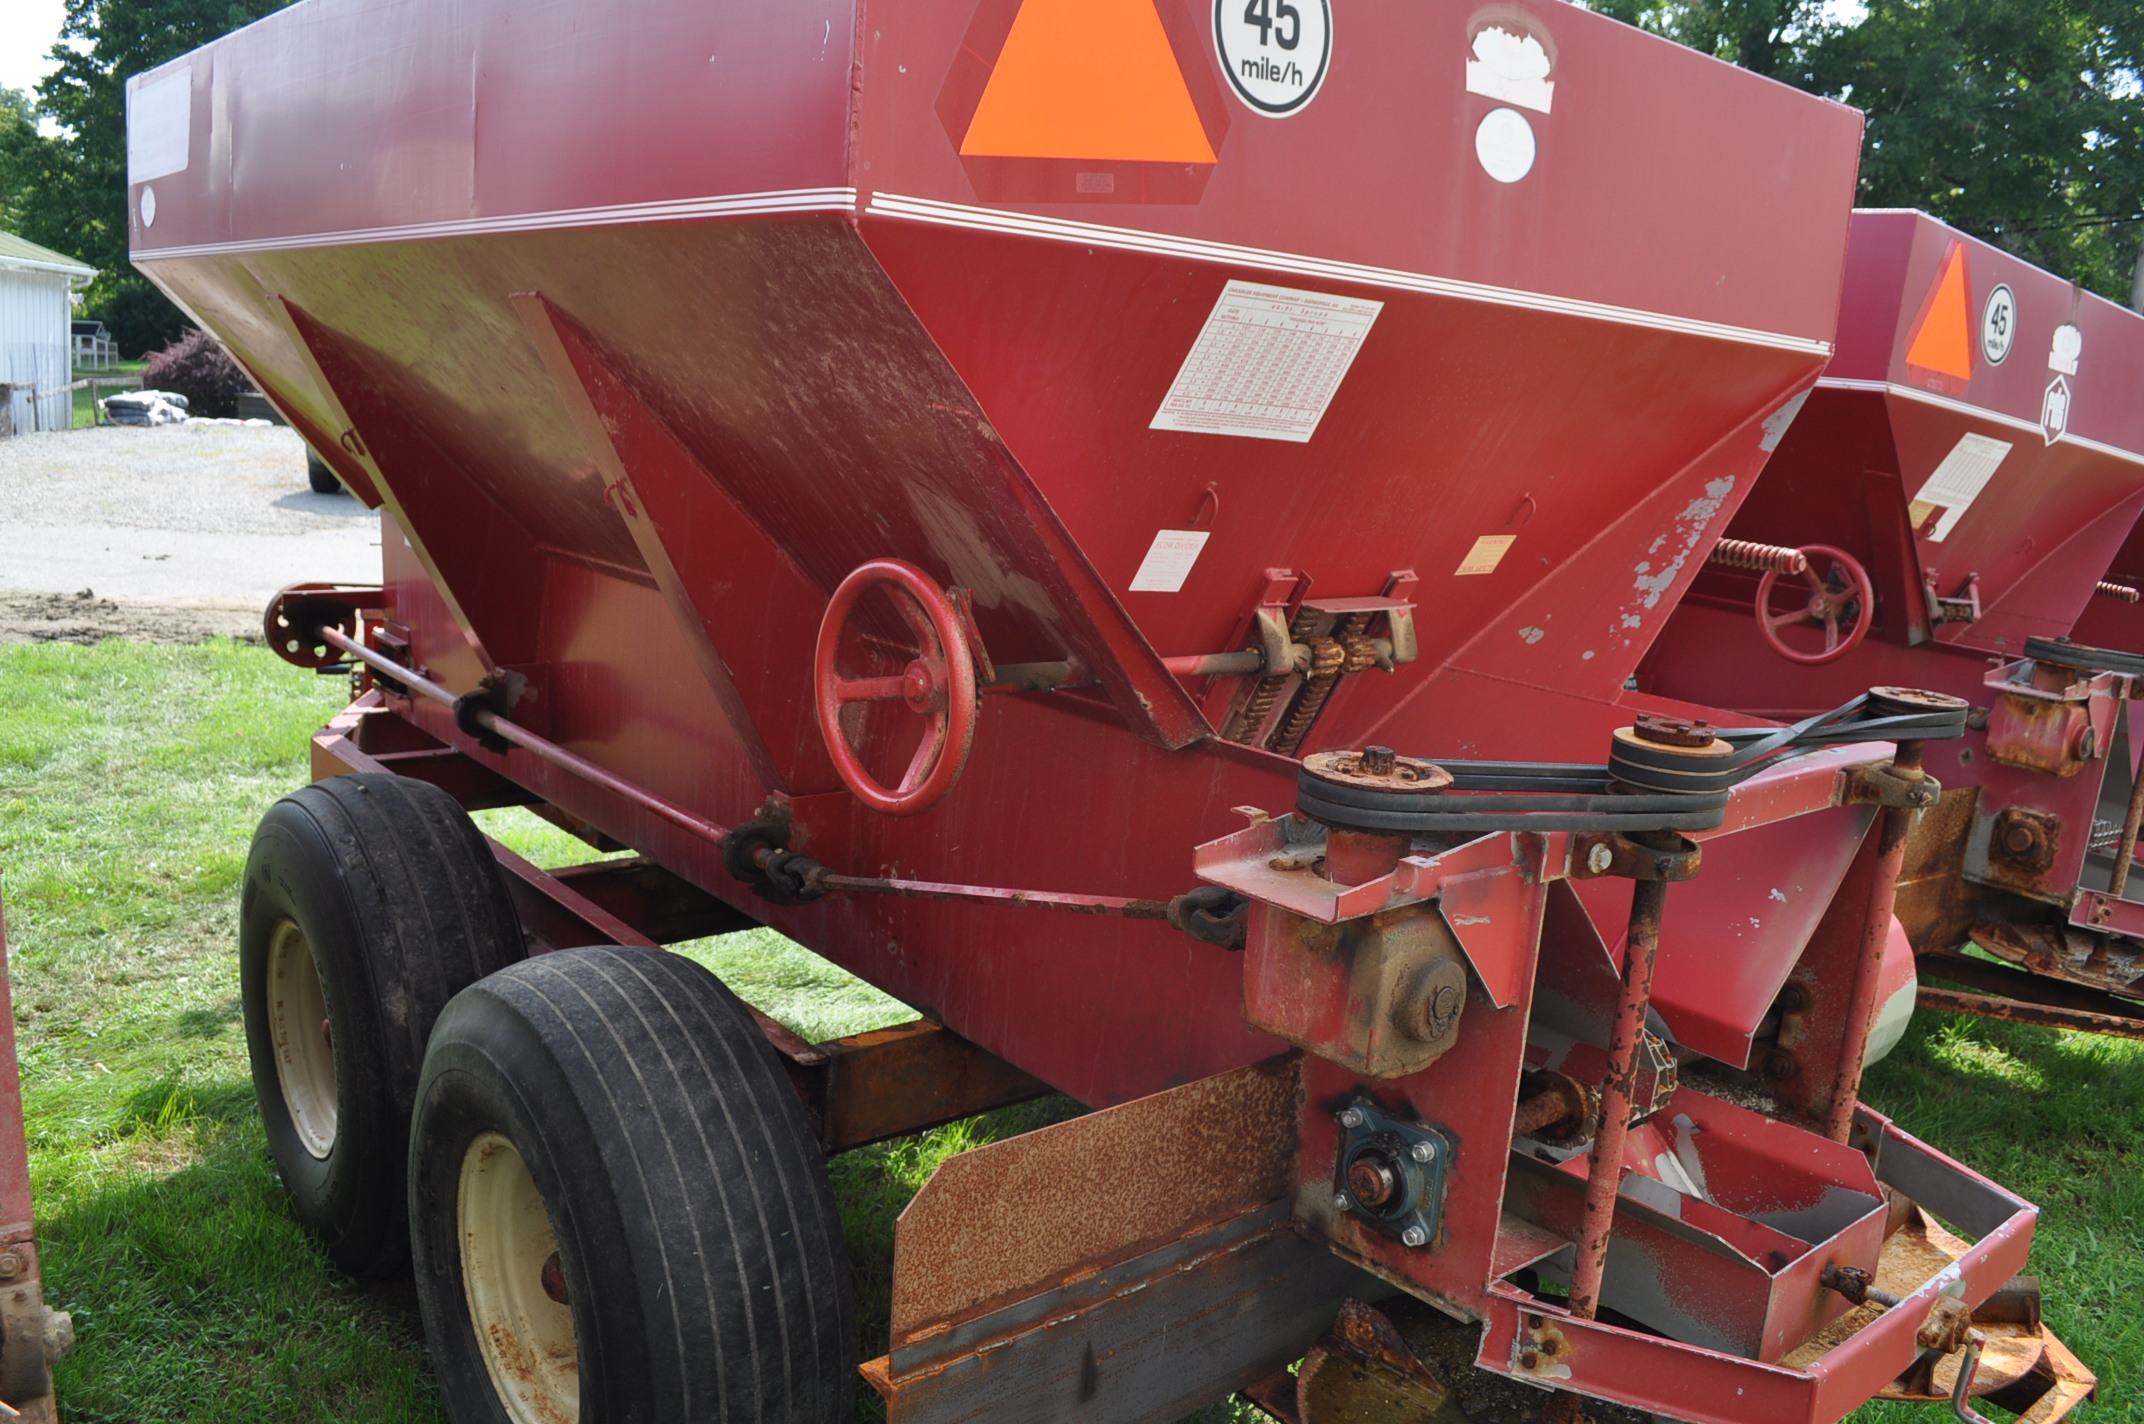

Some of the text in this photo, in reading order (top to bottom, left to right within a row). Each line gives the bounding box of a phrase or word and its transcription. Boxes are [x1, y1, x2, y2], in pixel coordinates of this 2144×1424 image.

[1243, 0, 1301, 51] 45
[1241, 56, 1303, 87] mile/h
[1991, 303, 2008, 336] 45
